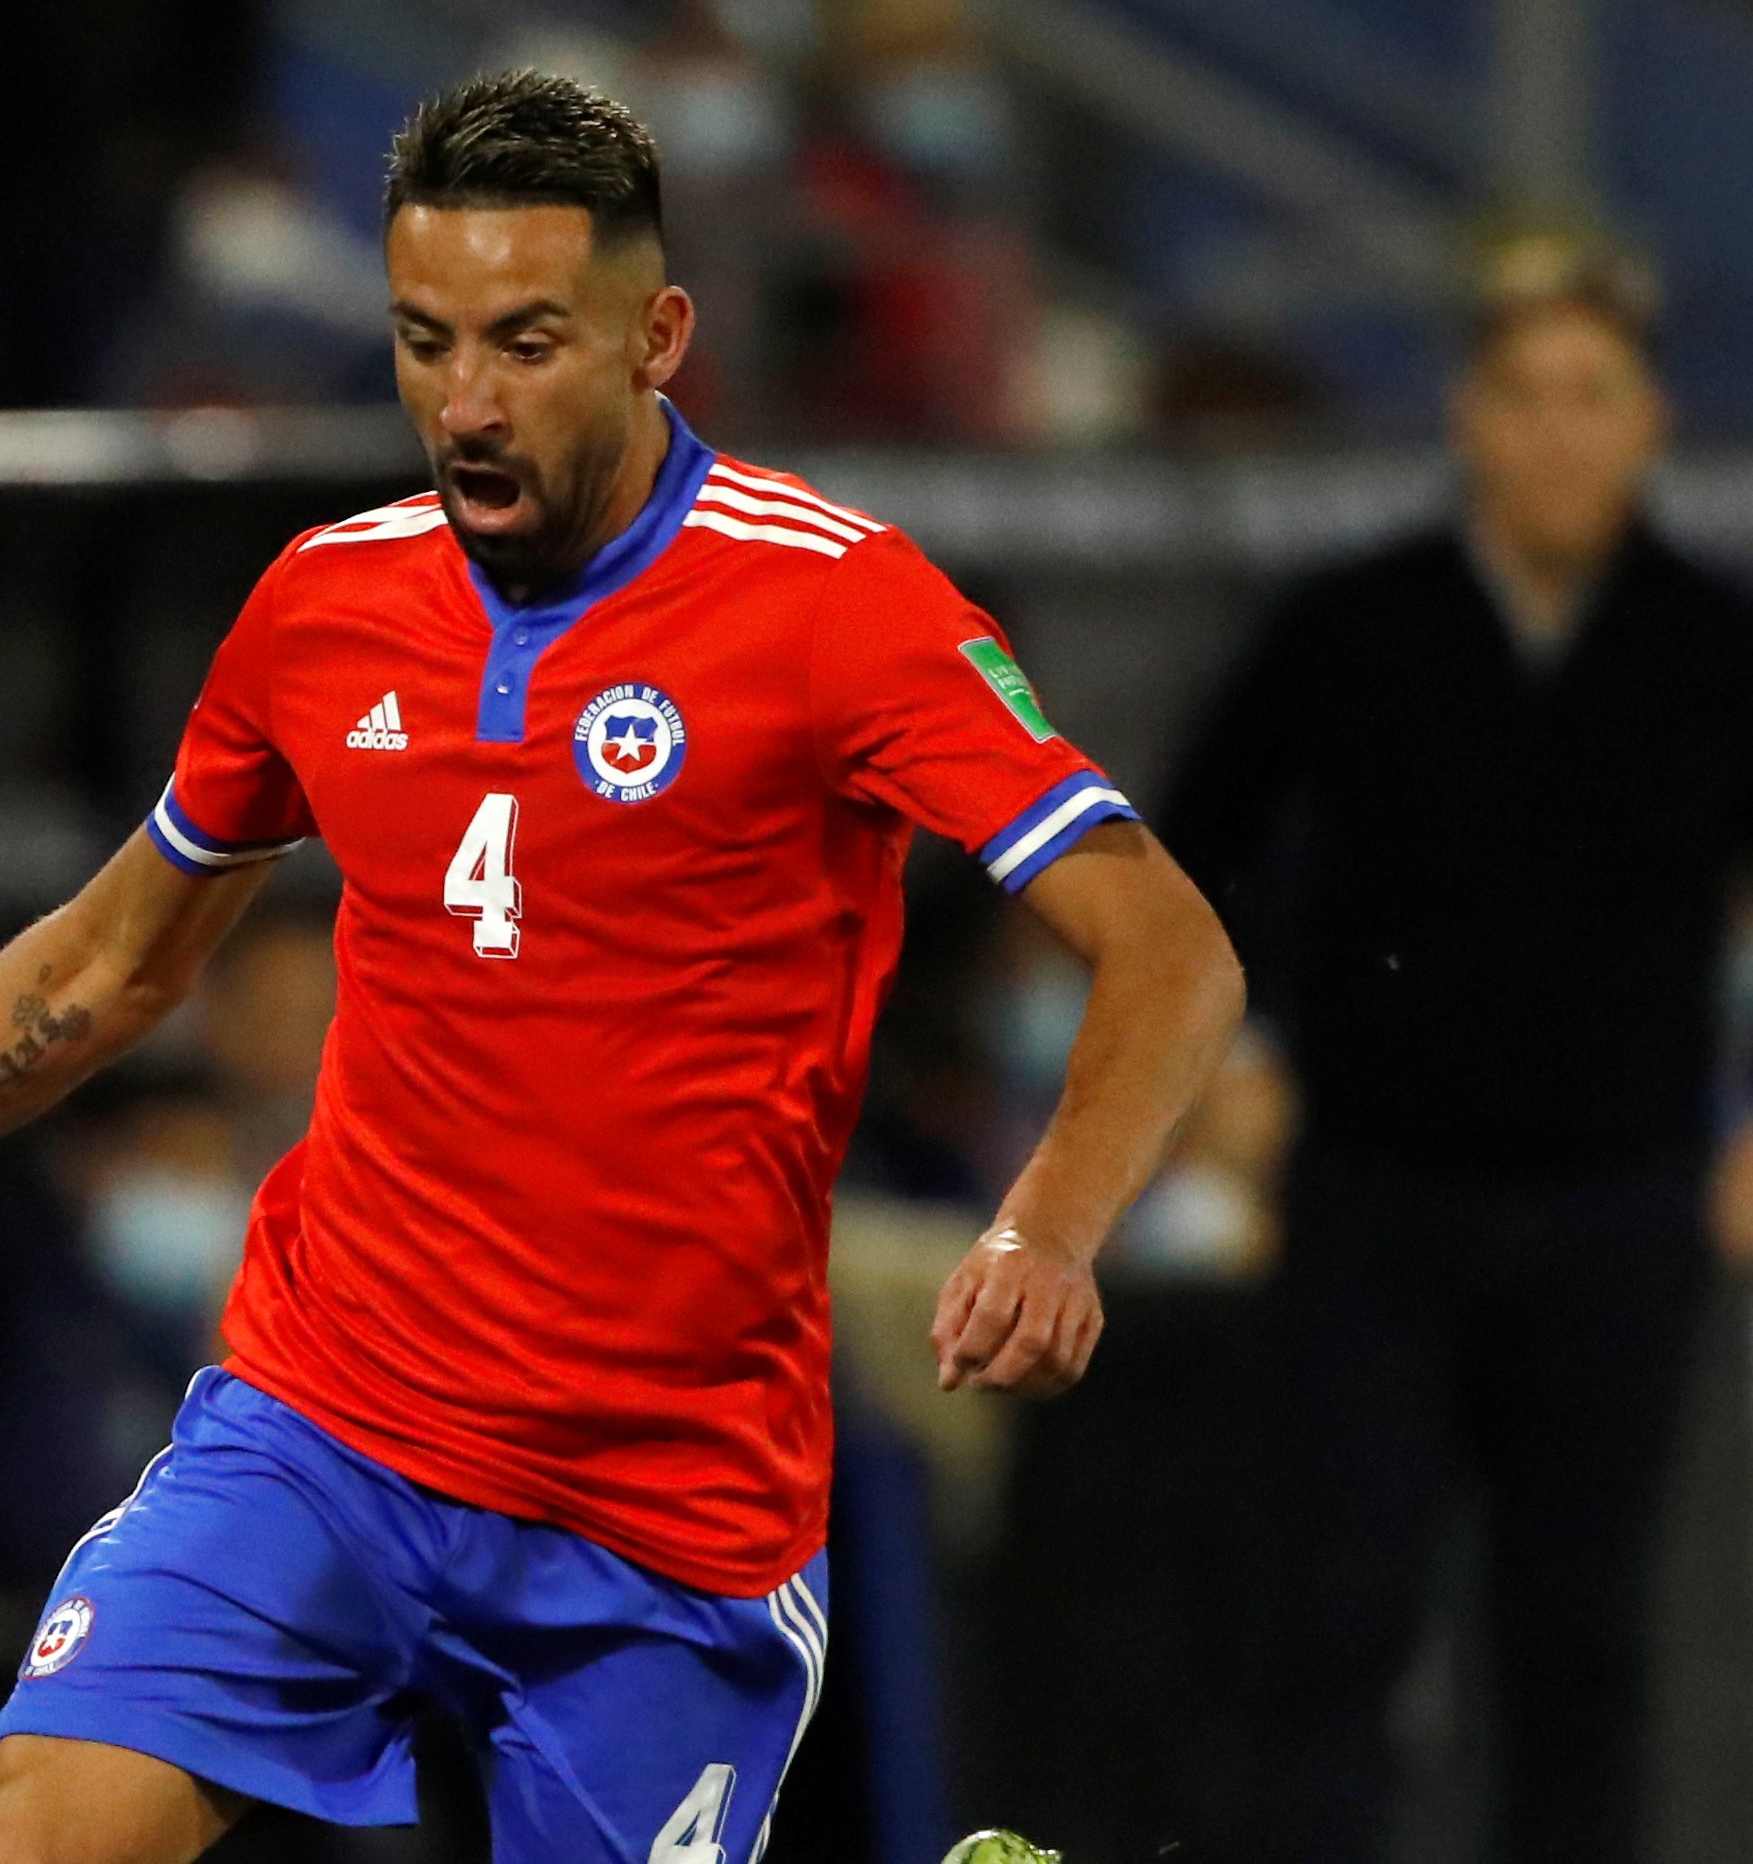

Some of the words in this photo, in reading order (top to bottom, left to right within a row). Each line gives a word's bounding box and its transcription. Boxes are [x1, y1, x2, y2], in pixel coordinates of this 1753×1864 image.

[347, 728, 408, 750] adidas
[575, 685, 634, 740] FEDERACION
[642, 687, 659, 703] DE
[659, 699, 685, 746] FUTBOL
[597, 781, 615, 798] DE
[621, 782, 656, 801] CHILE
[444, 793, 522, 959] 4
[647, 1763, 737, 1864] 4
